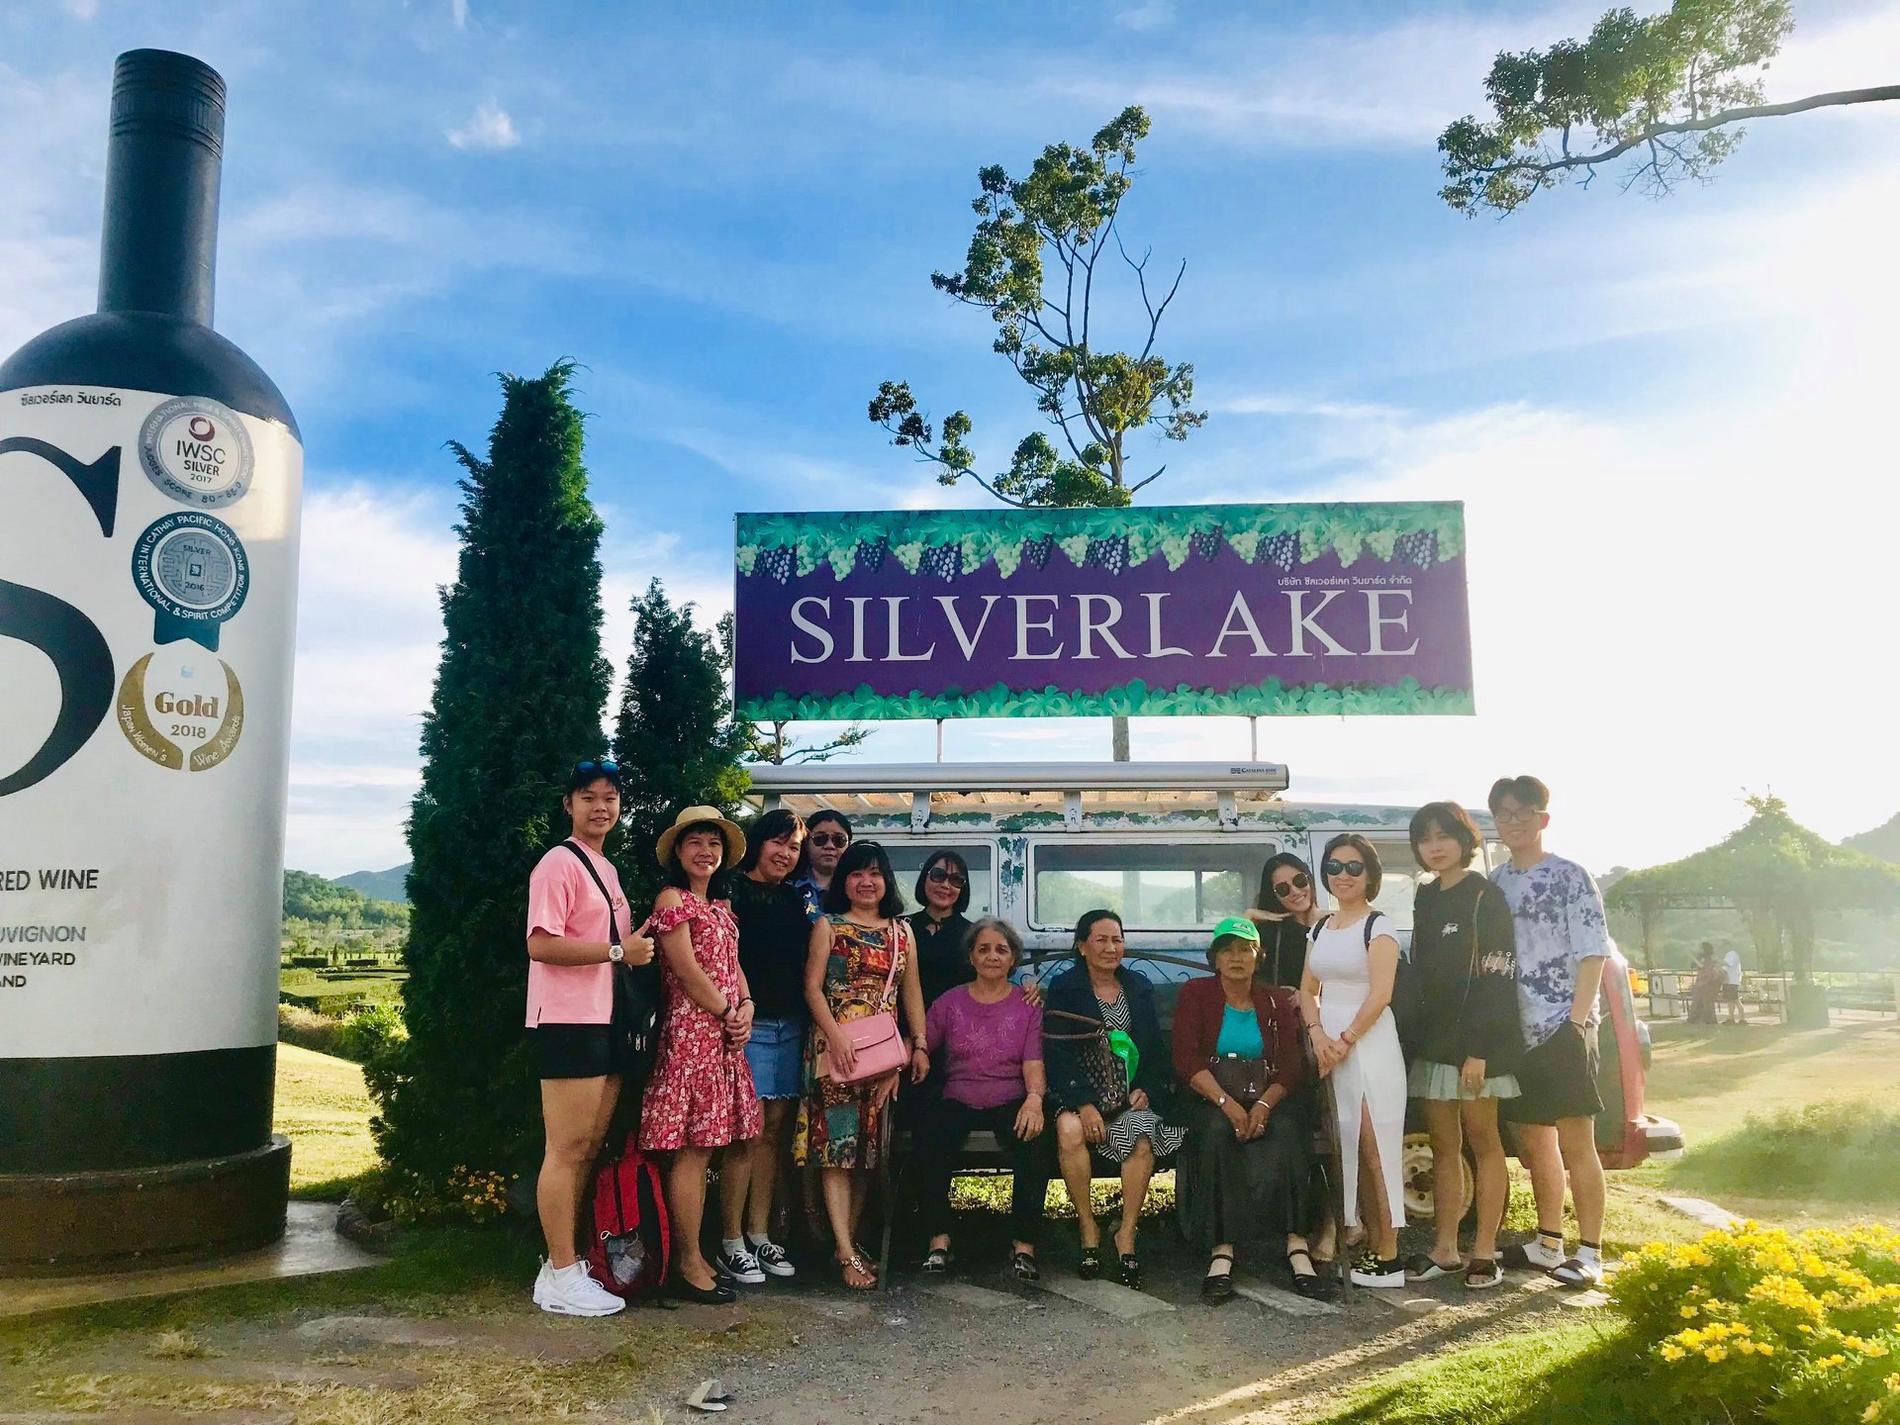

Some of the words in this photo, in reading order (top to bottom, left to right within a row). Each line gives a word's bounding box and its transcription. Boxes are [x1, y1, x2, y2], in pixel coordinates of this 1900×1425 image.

[77, 392, 121, 406] วินยาร์ด
[176, 439, 226, 464] IWSC
[184, 460, 220, 476] SILVER
[190, 473, 212, 484] 2017
[146, 518, 175, 543] CATHAY
[177, 515, 213, 527] PACIFIC
[214, 523, 236, 546] HONG
[232, 546, 245, 571] KONG
[183, 544, 212, 555] SILVER
[172, 607, 181, 617] &
[181, 609, 209, 620] SPIRIT
[210, 575, 245, 618] COMPETITION
[789, 588, 1420, 665] SILVERLAKE
[154, 691, 219, 719] Gold
[170, 724, 206, 739] 2018
[193, 751, 220, 766] Wine
[38, 869, 99, 890] WINE
[0, 952, 76, 966] INEYARD
[0, 975, 27, 988] ND
